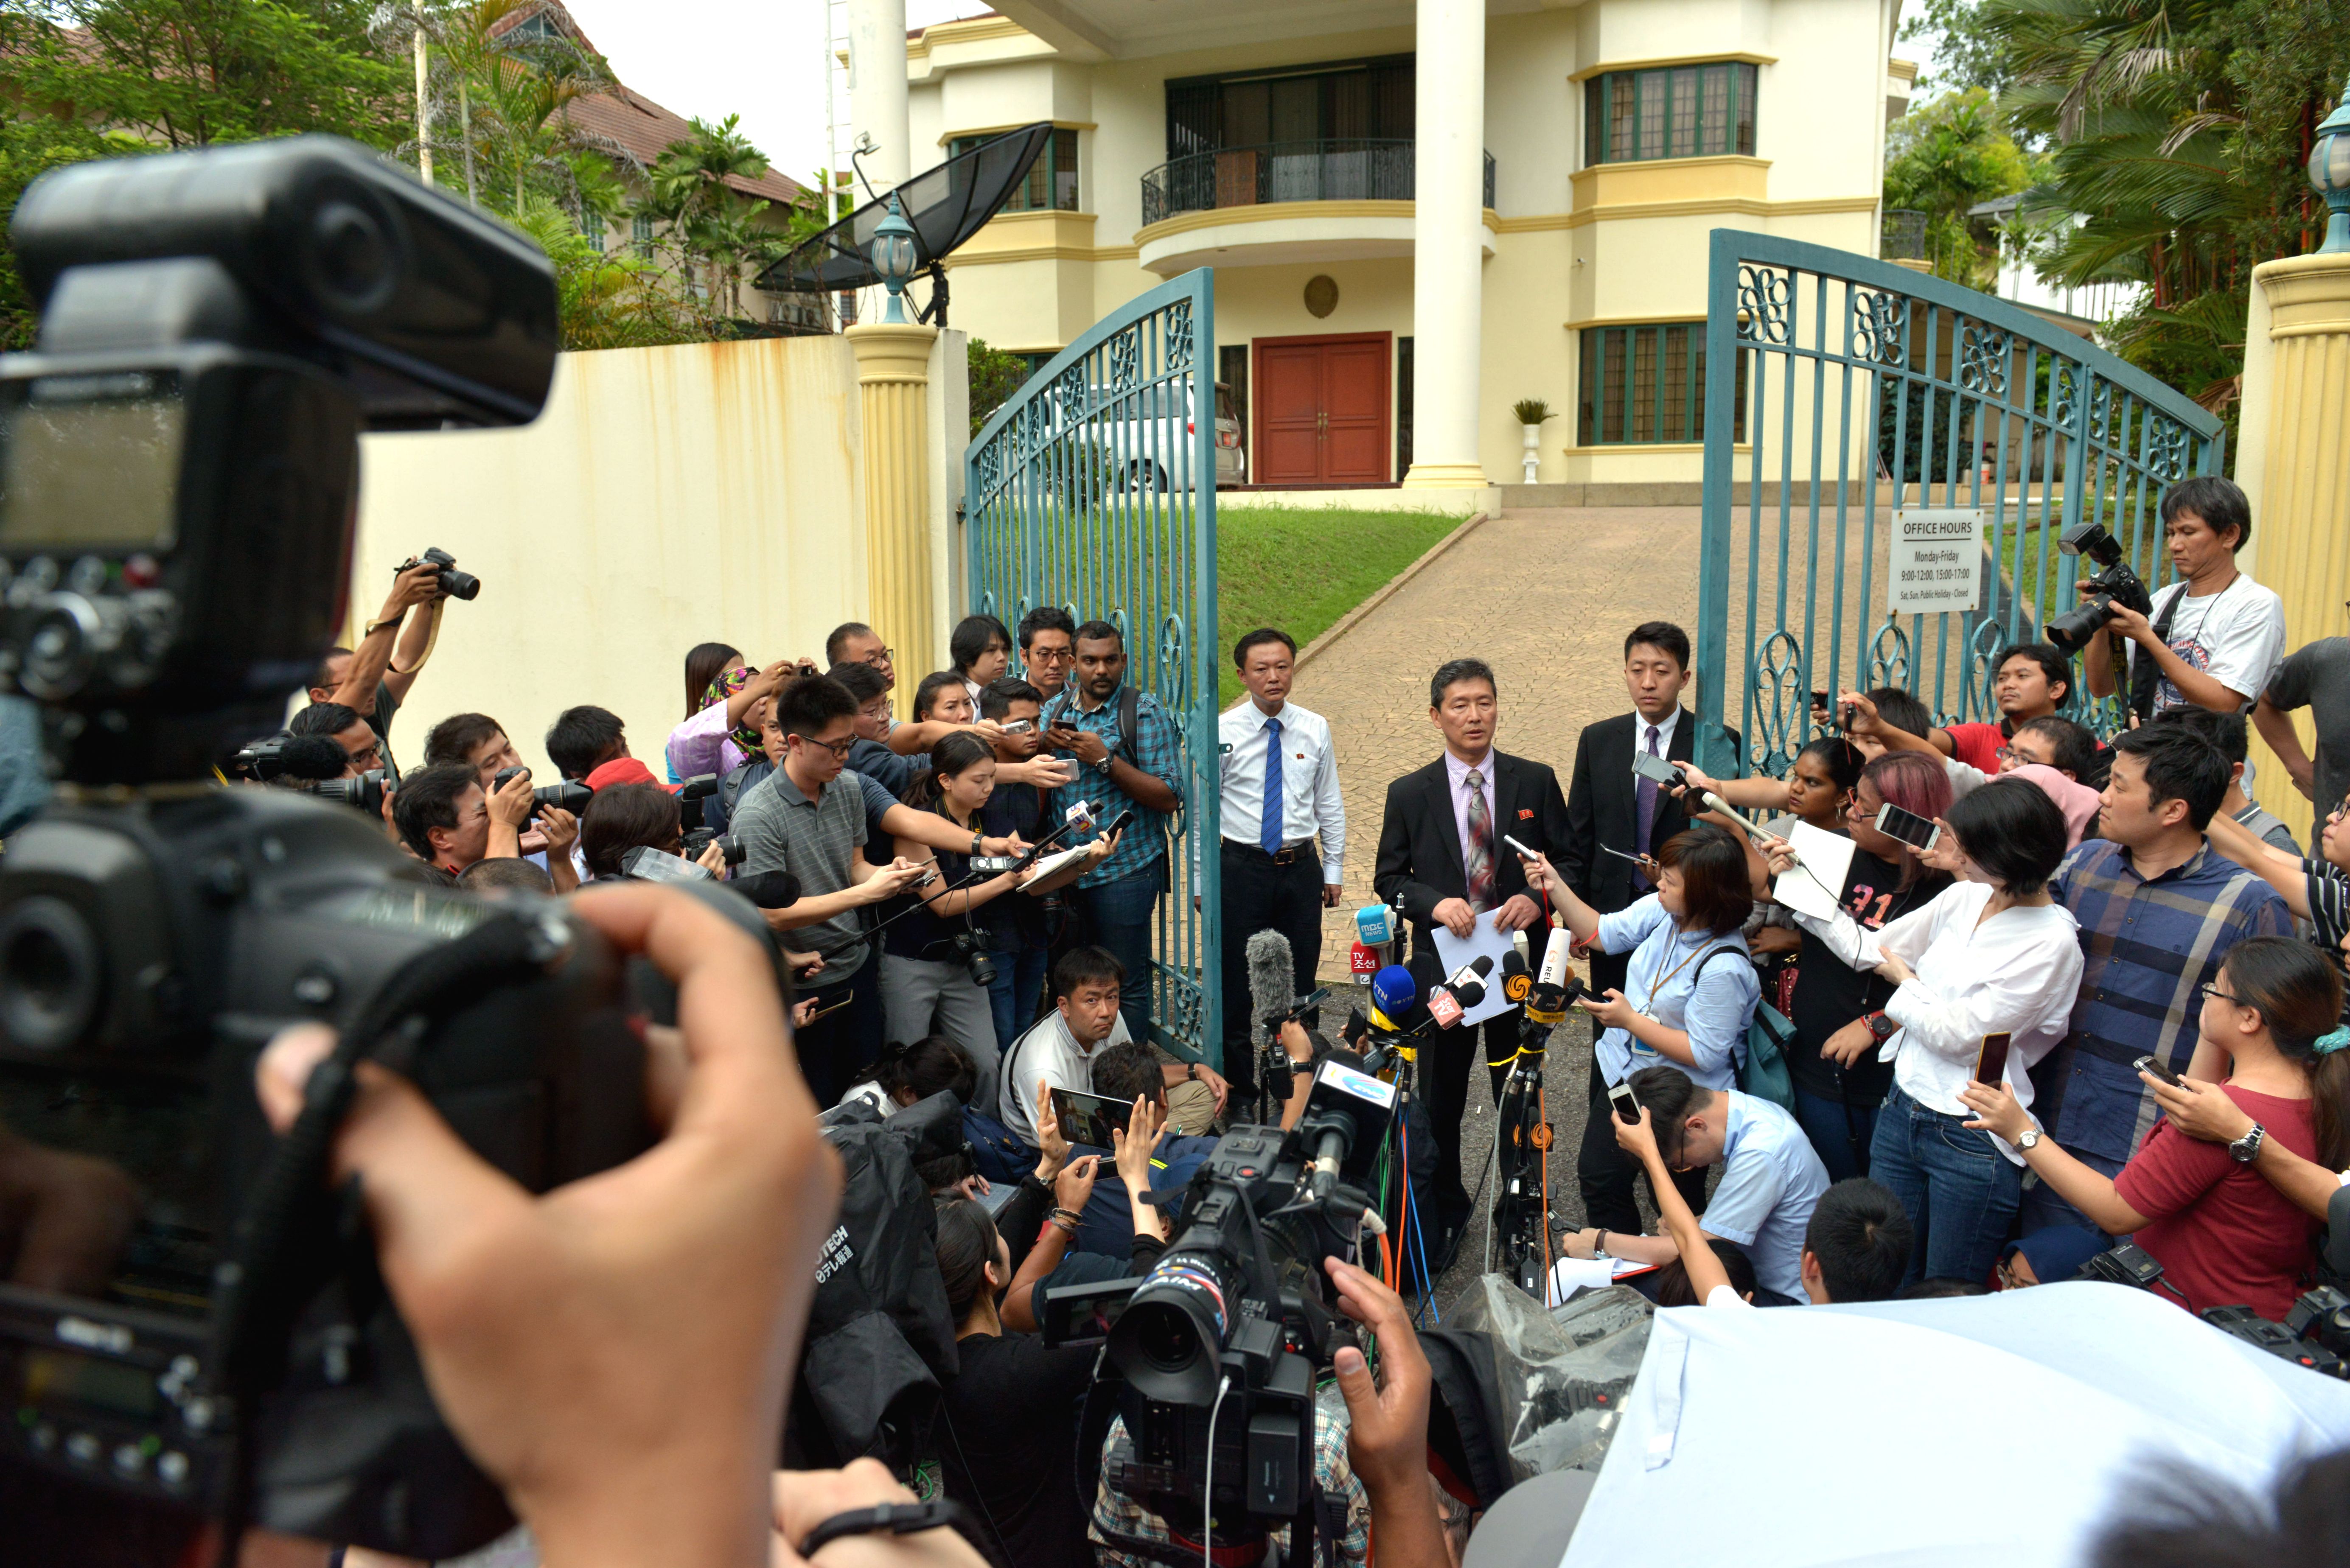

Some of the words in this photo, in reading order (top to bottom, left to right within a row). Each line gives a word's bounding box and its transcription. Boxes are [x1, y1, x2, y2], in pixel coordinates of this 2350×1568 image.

[1904, 523, 1937, 534] OFFICE
[1940, 522, 1972, 533] HOURS
[1915, 550, 1959, 564] Monday-Friday
[1901, 570, 1934, 582] 9:00-12:00,
[1936, 568, 1969, 580] 15:00-17:00
[1901, 591, 1909, 601] Sat,
[1910, 591, 1919, 601] Sun,
[1920, 590, 1933, 599] Public
[1935, 589, 1951, 600] Holiday
[1954, 588, 1968, 597] Closed
[1844, 884, 1893, 929] 31
[1361, 922, 1384, 932] MBC
[1354, 960, 1376, 969] 조선
[1374, 980, 1388, 1001] YTN
[1434, 1000, 1449, 1016] TV
[1442, 997, 1455, 1013] Star
